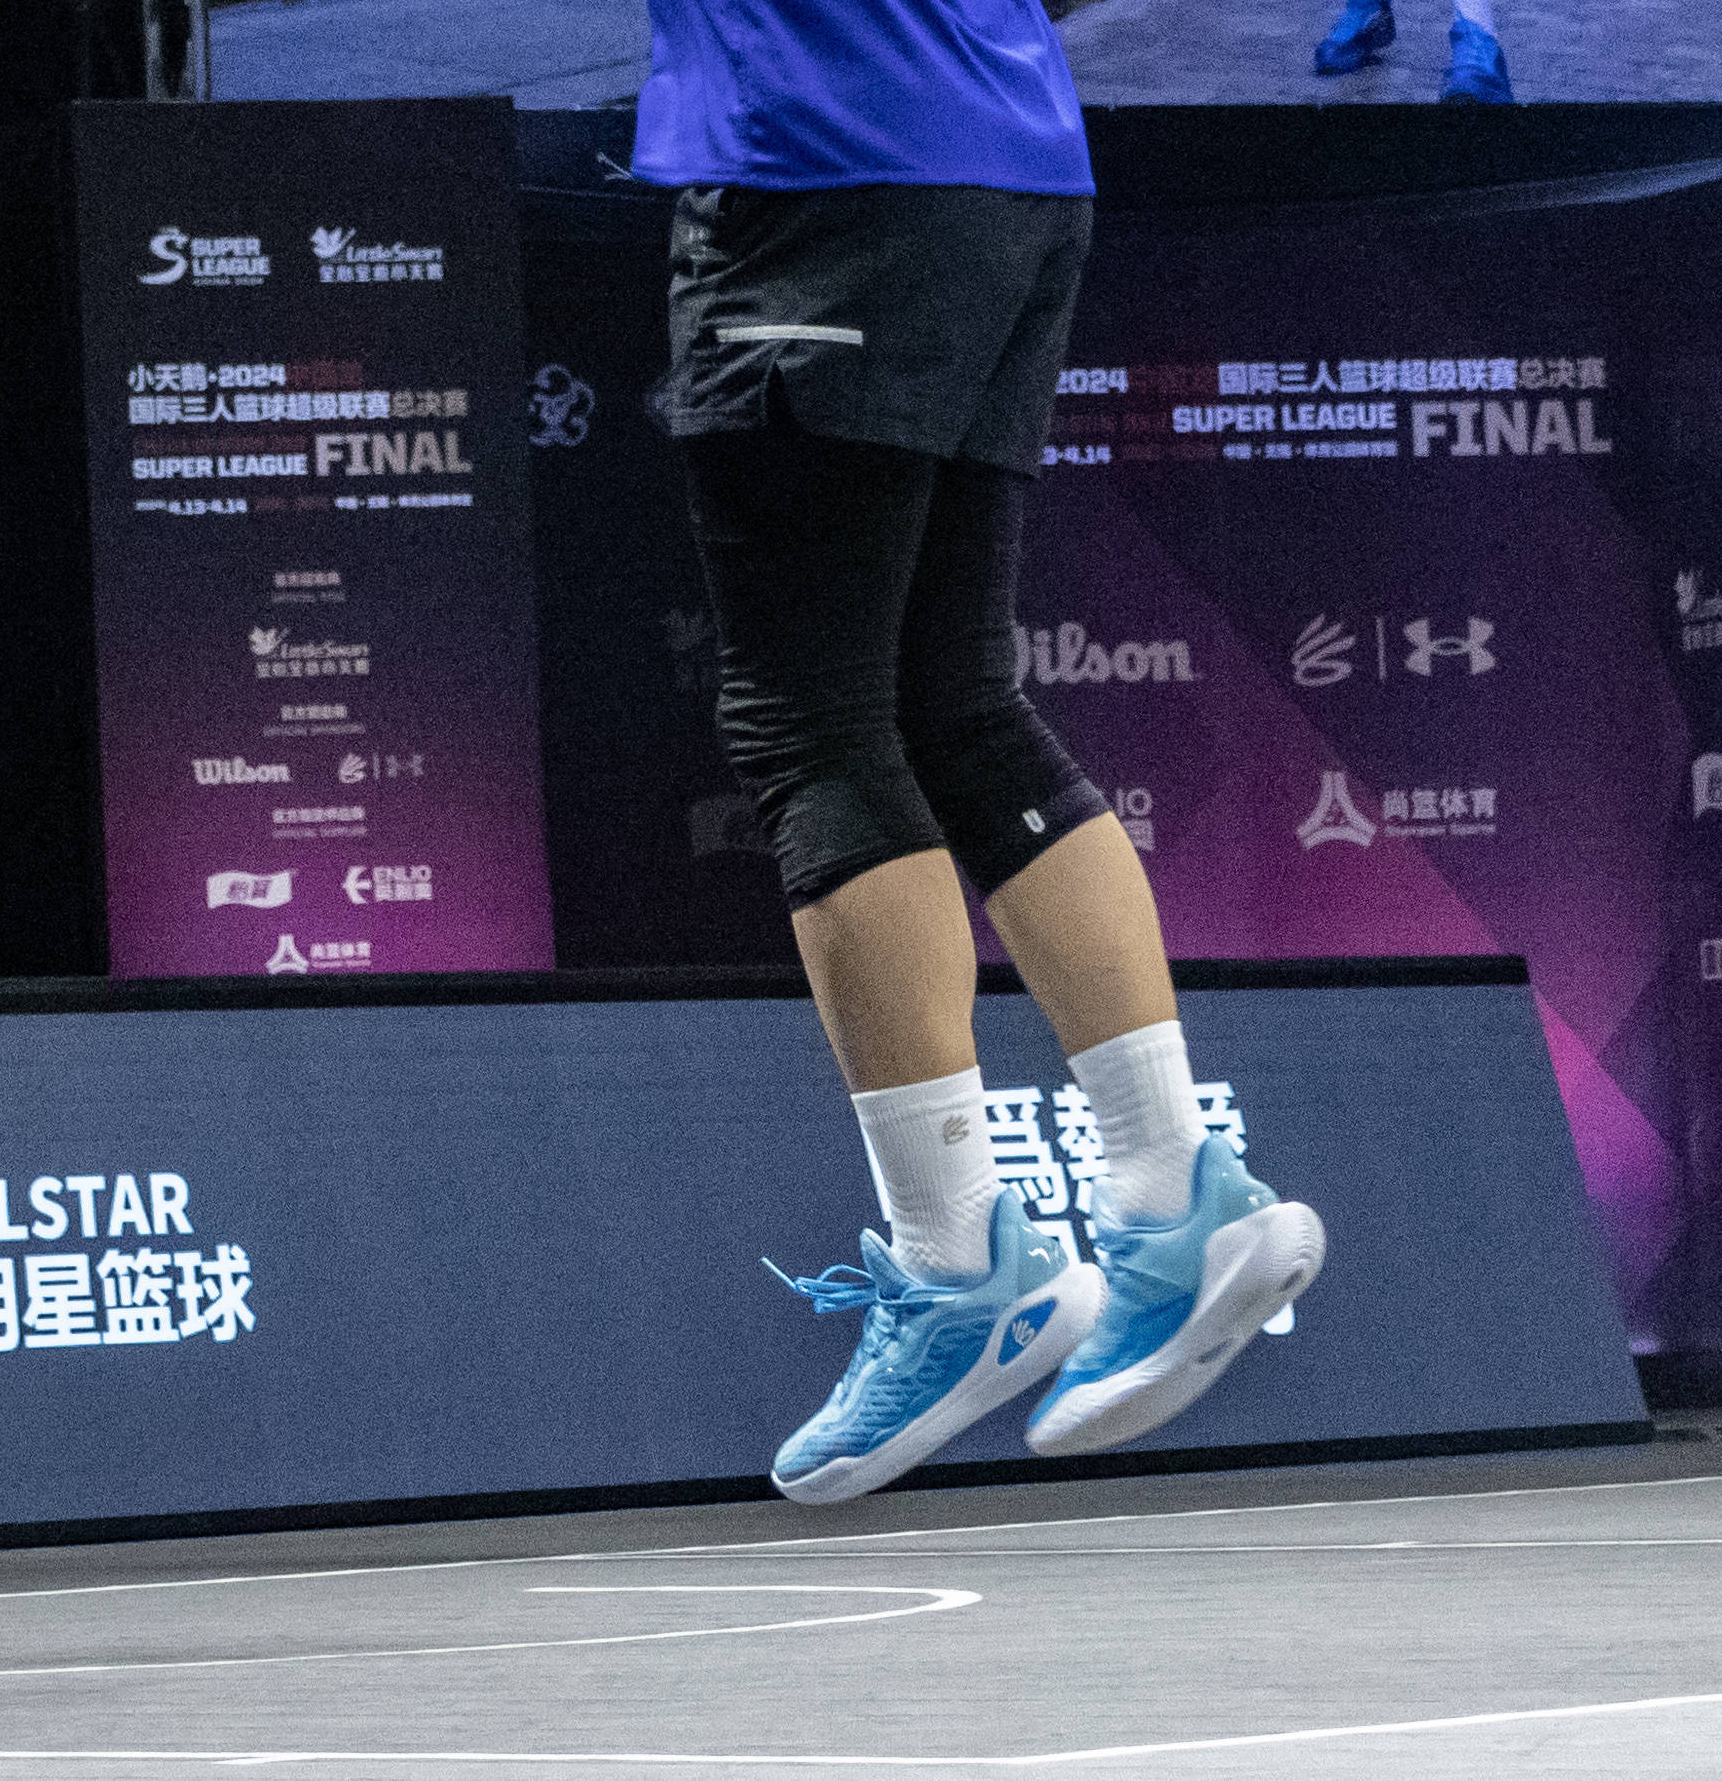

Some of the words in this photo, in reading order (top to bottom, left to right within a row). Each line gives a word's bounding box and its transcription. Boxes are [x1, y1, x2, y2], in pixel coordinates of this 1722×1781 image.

[190, 236, 262, 258] SUPER
[192, 255, 272, 277] LEAGUE
[1171, 404, 1277, 434] SUPER
[1280, 402, 1398, 432] LEAGUE
[1410, 398, 1613, 458] FINAL
[132, 456, 214, 480] SUPER
[217, 452, 308, 478] LEAGUE
[314, 429, 473, 477] FINAL
[191, 755, 293, 785] Wilson
